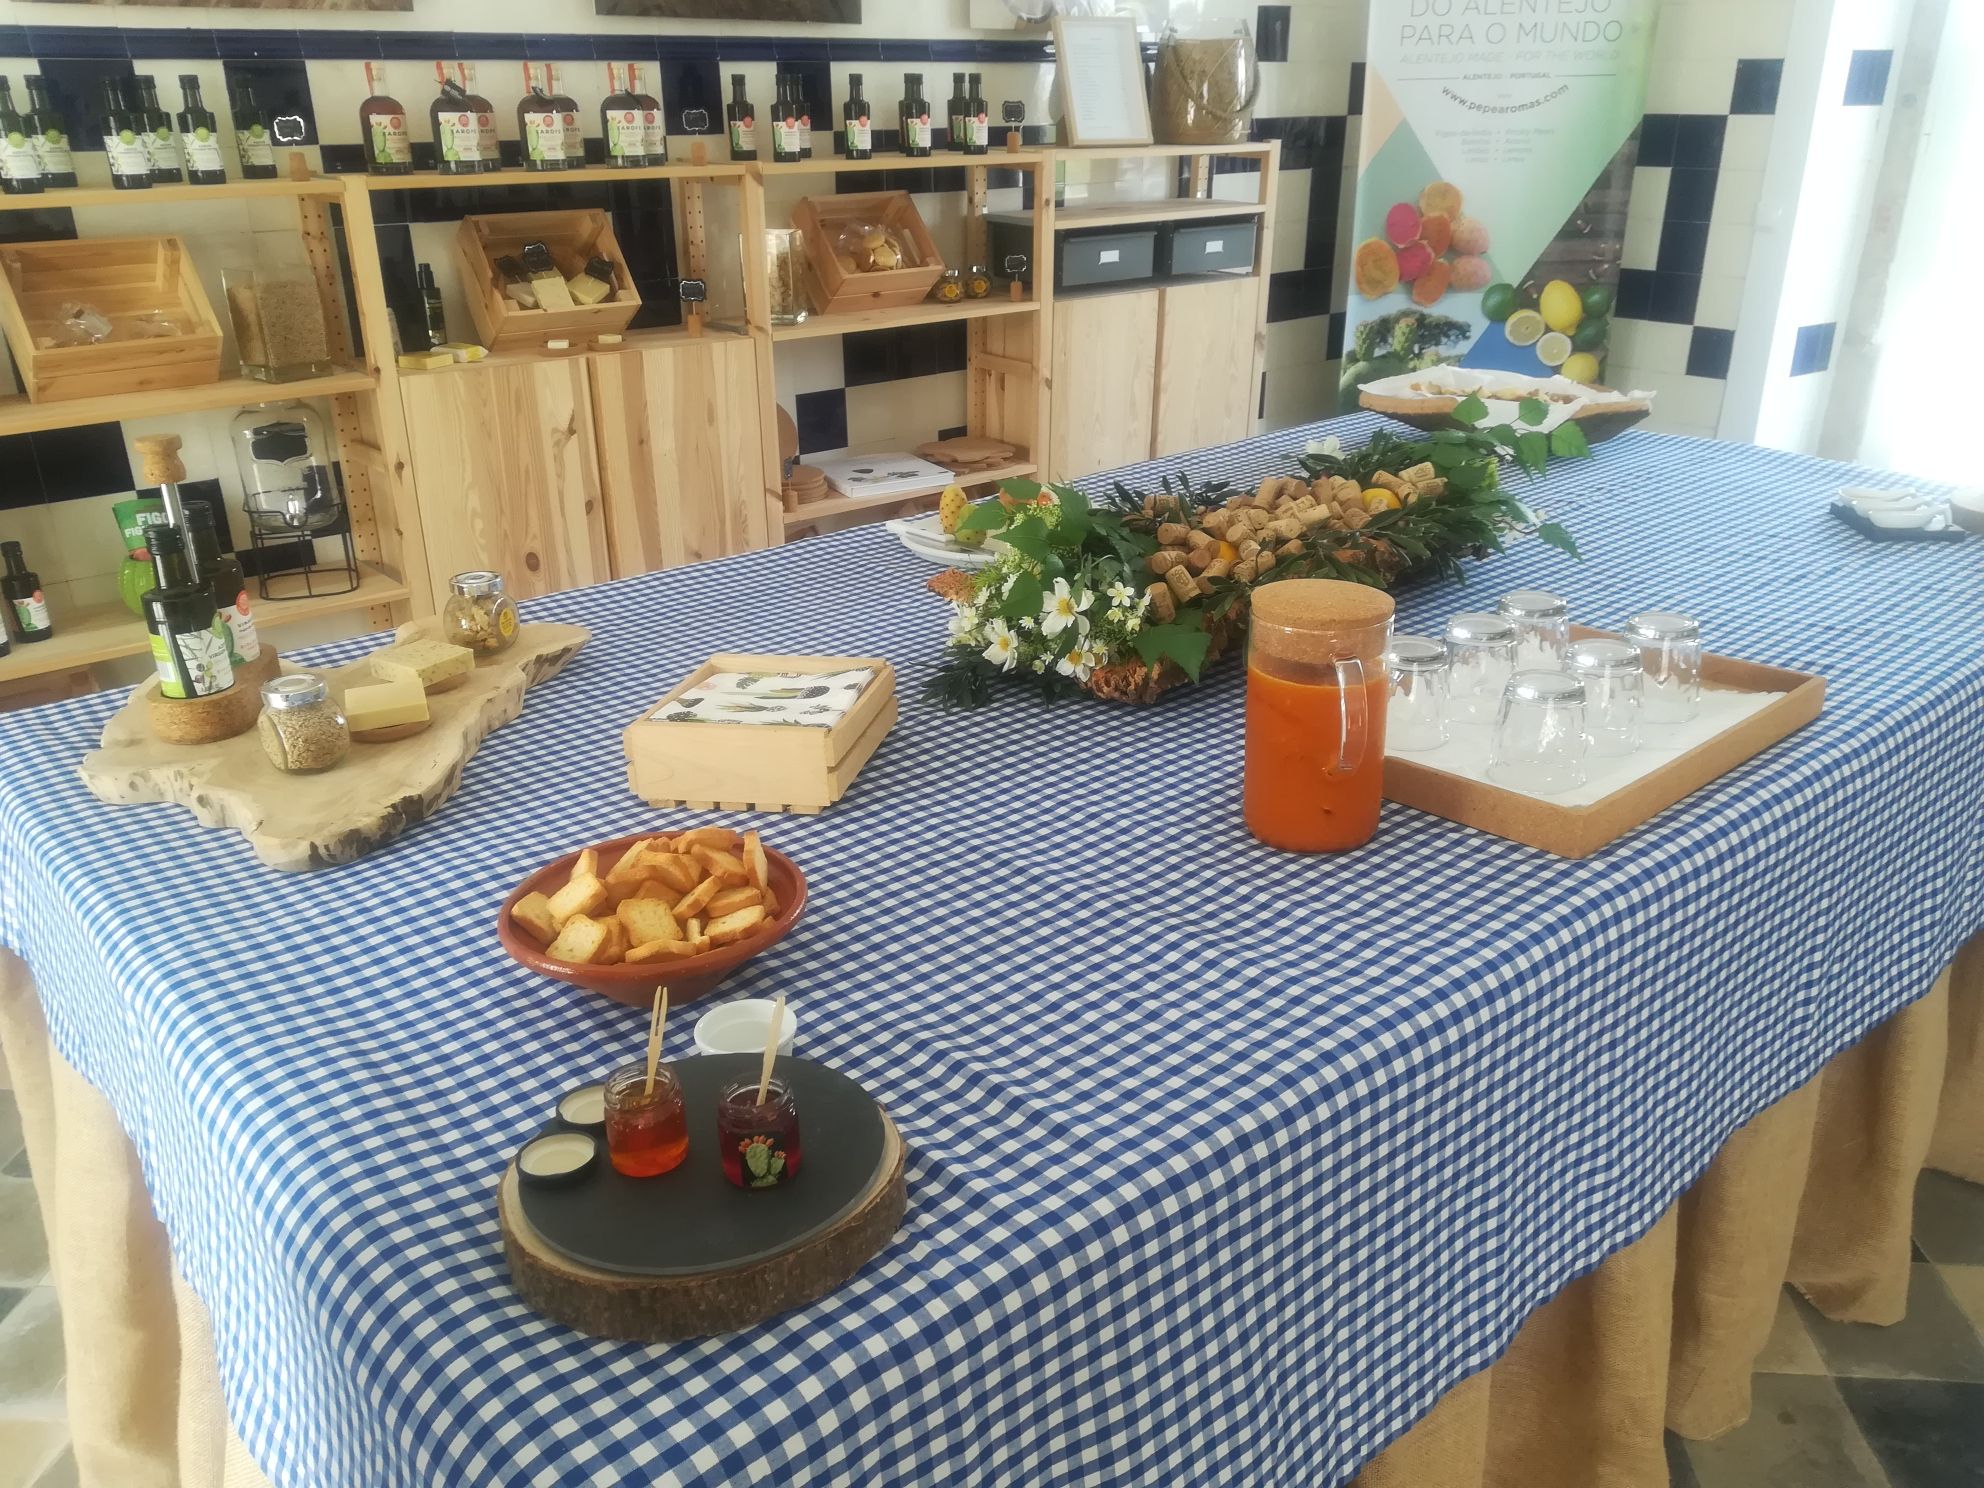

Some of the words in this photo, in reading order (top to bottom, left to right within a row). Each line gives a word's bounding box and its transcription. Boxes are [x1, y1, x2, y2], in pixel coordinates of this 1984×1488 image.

[1410, 0, 1452, 17] DO
[1461, 0, 1612, 15] ALENTEJO
[1400, 24, 1476, 46] PARA
[1486, 22, 1506, 45] O
[1516, 20, 1624, 43] MUNDO
[1441, 83, 1569, 114] www.pepearomas.com
